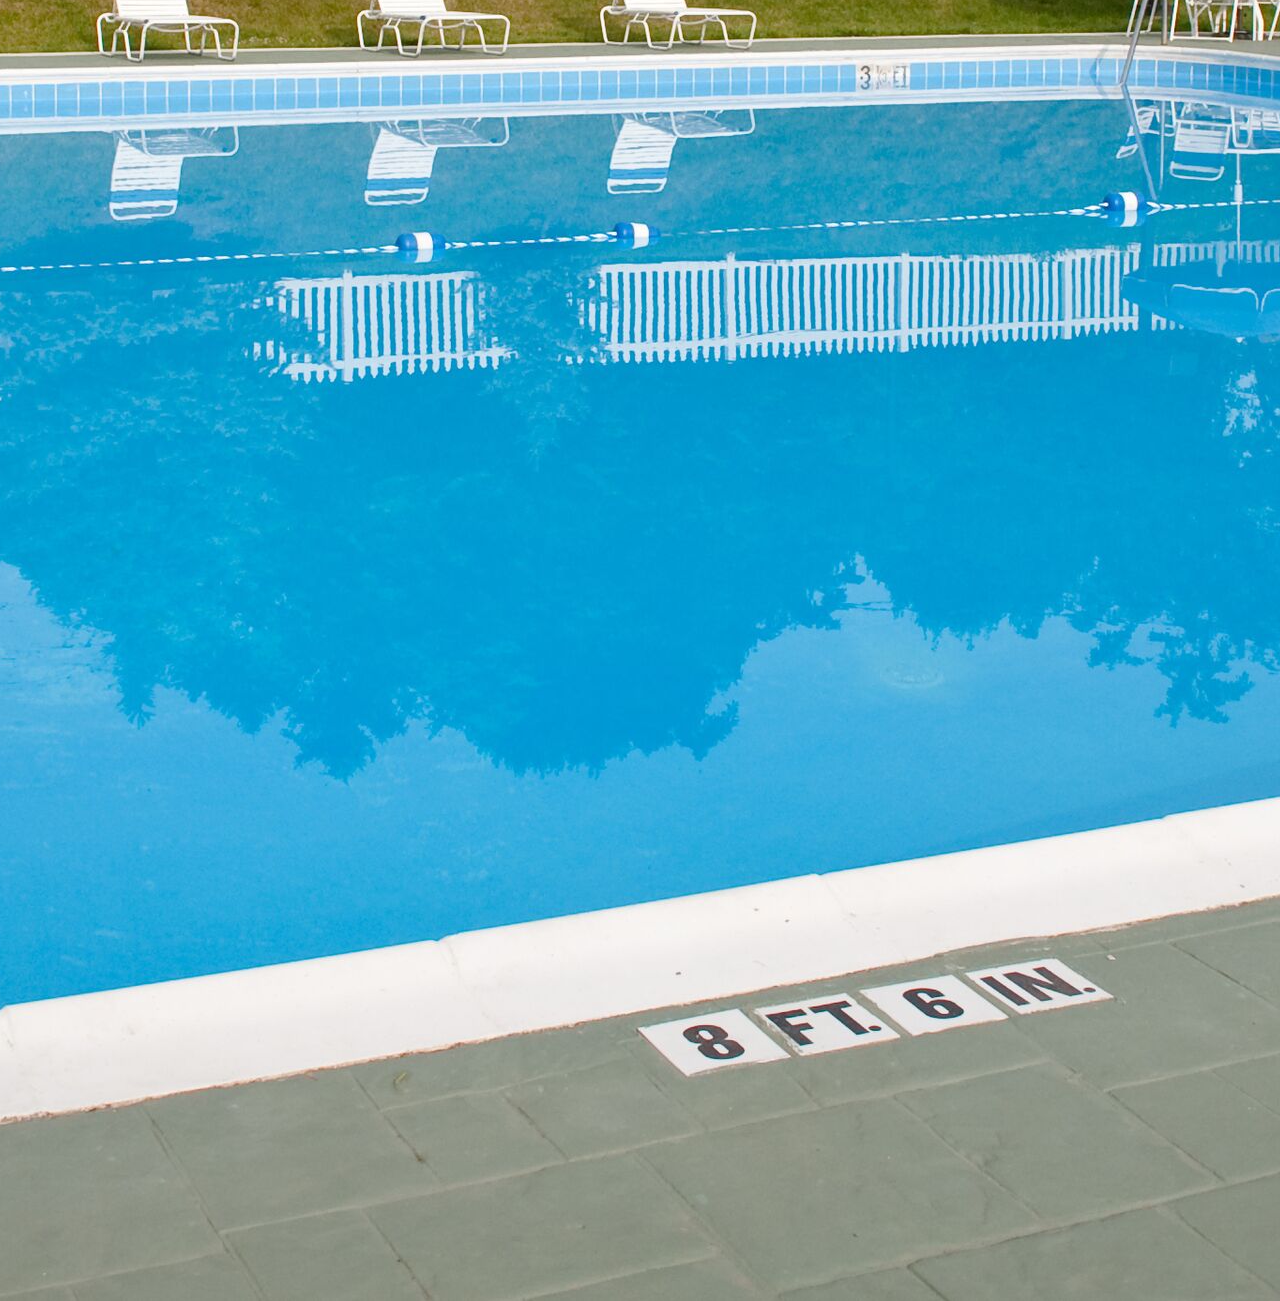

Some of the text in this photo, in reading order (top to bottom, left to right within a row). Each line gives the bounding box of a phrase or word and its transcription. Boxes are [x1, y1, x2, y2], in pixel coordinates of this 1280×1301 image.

[683, 966, 1097, 1061] 8 FT. 6 IN.
